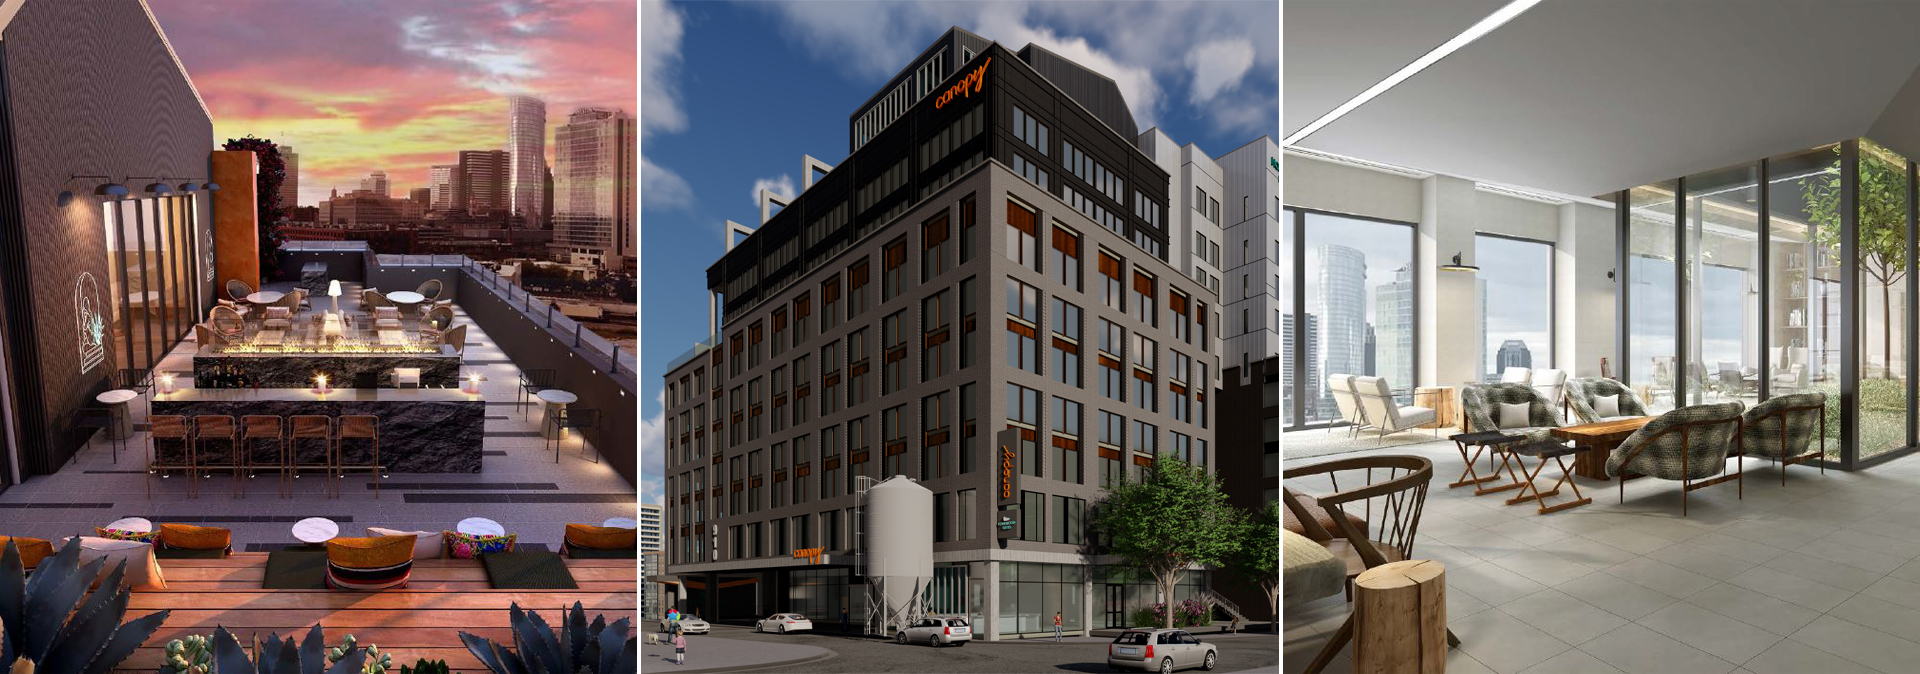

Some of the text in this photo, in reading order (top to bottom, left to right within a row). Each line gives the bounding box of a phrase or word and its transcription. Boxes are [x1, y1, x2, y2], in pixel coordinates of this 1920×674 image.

[935, 57, 992, 109] canopy
[1003, 445, 1015, 498] canopy
[793, 546, 825, 565] canopy
